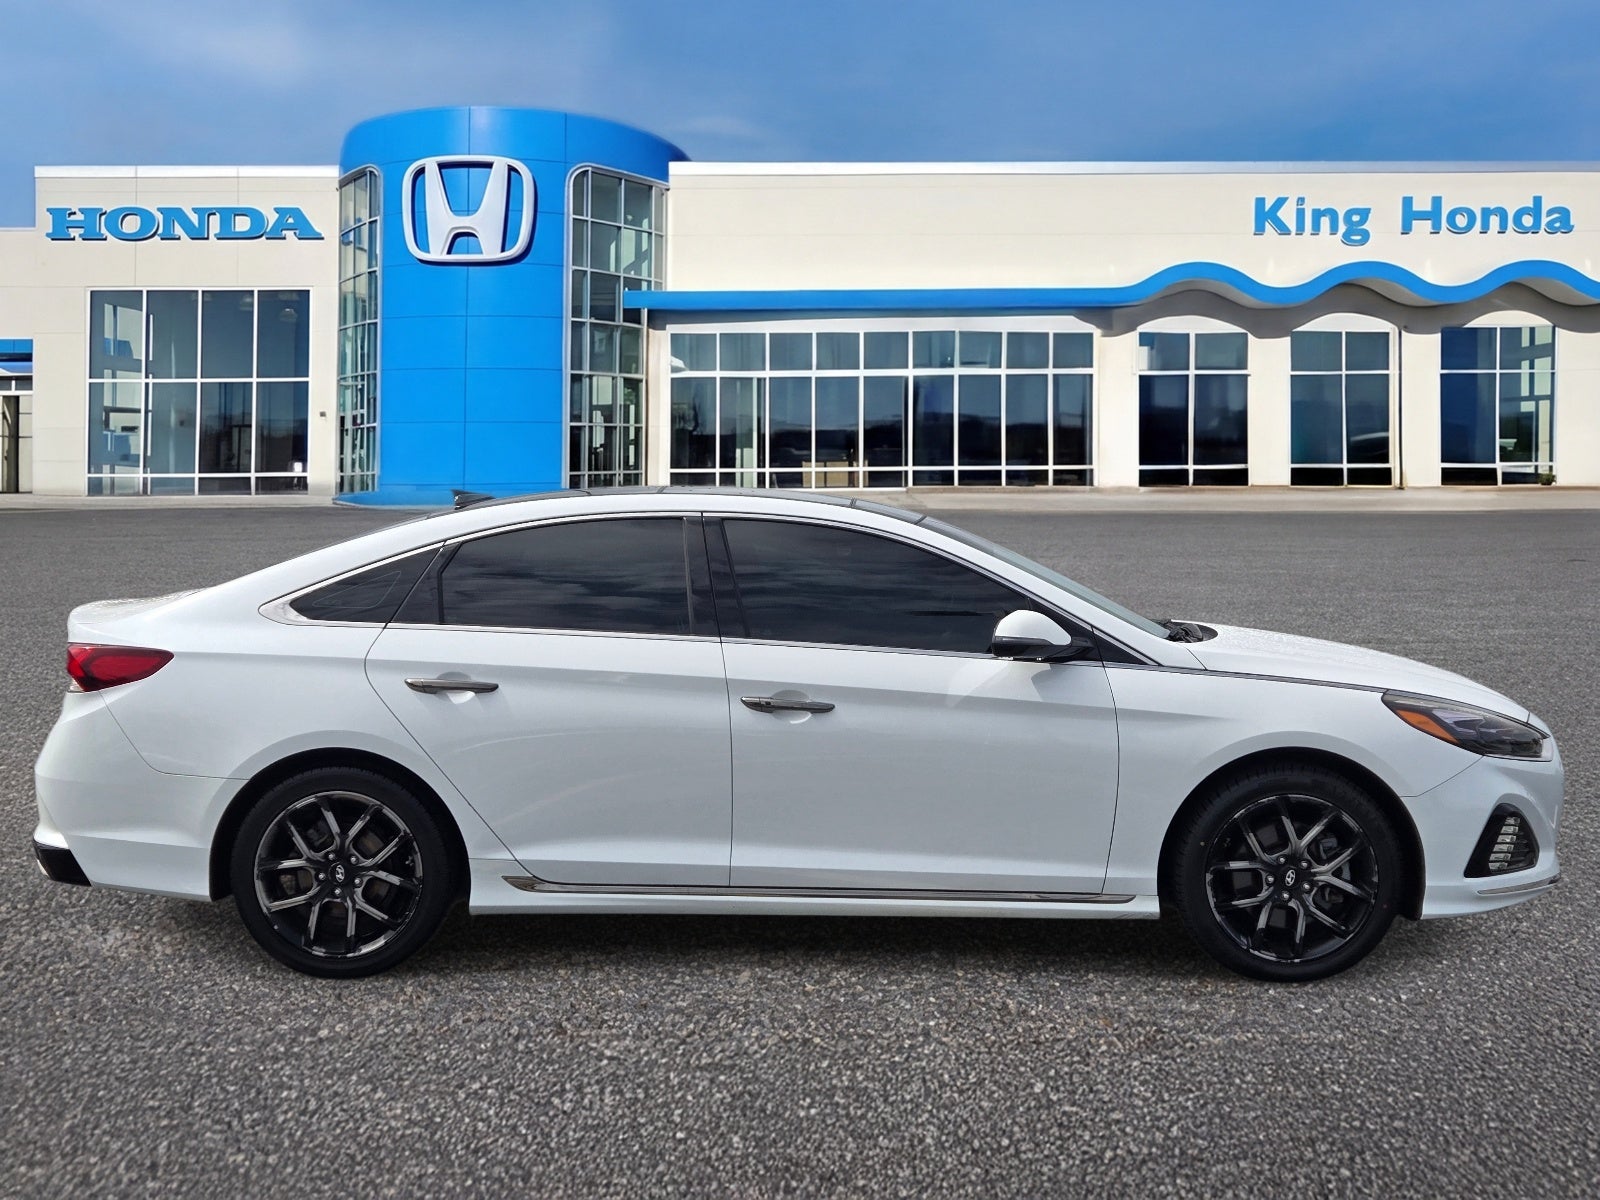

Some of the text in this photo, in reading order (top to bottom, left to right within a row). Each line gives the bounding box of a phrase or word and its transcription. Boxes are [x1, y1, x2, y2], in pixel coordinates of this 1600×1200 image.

[46, 206, 324, 241] HONDA
[1253, 195, 1574, 246] King Honda
